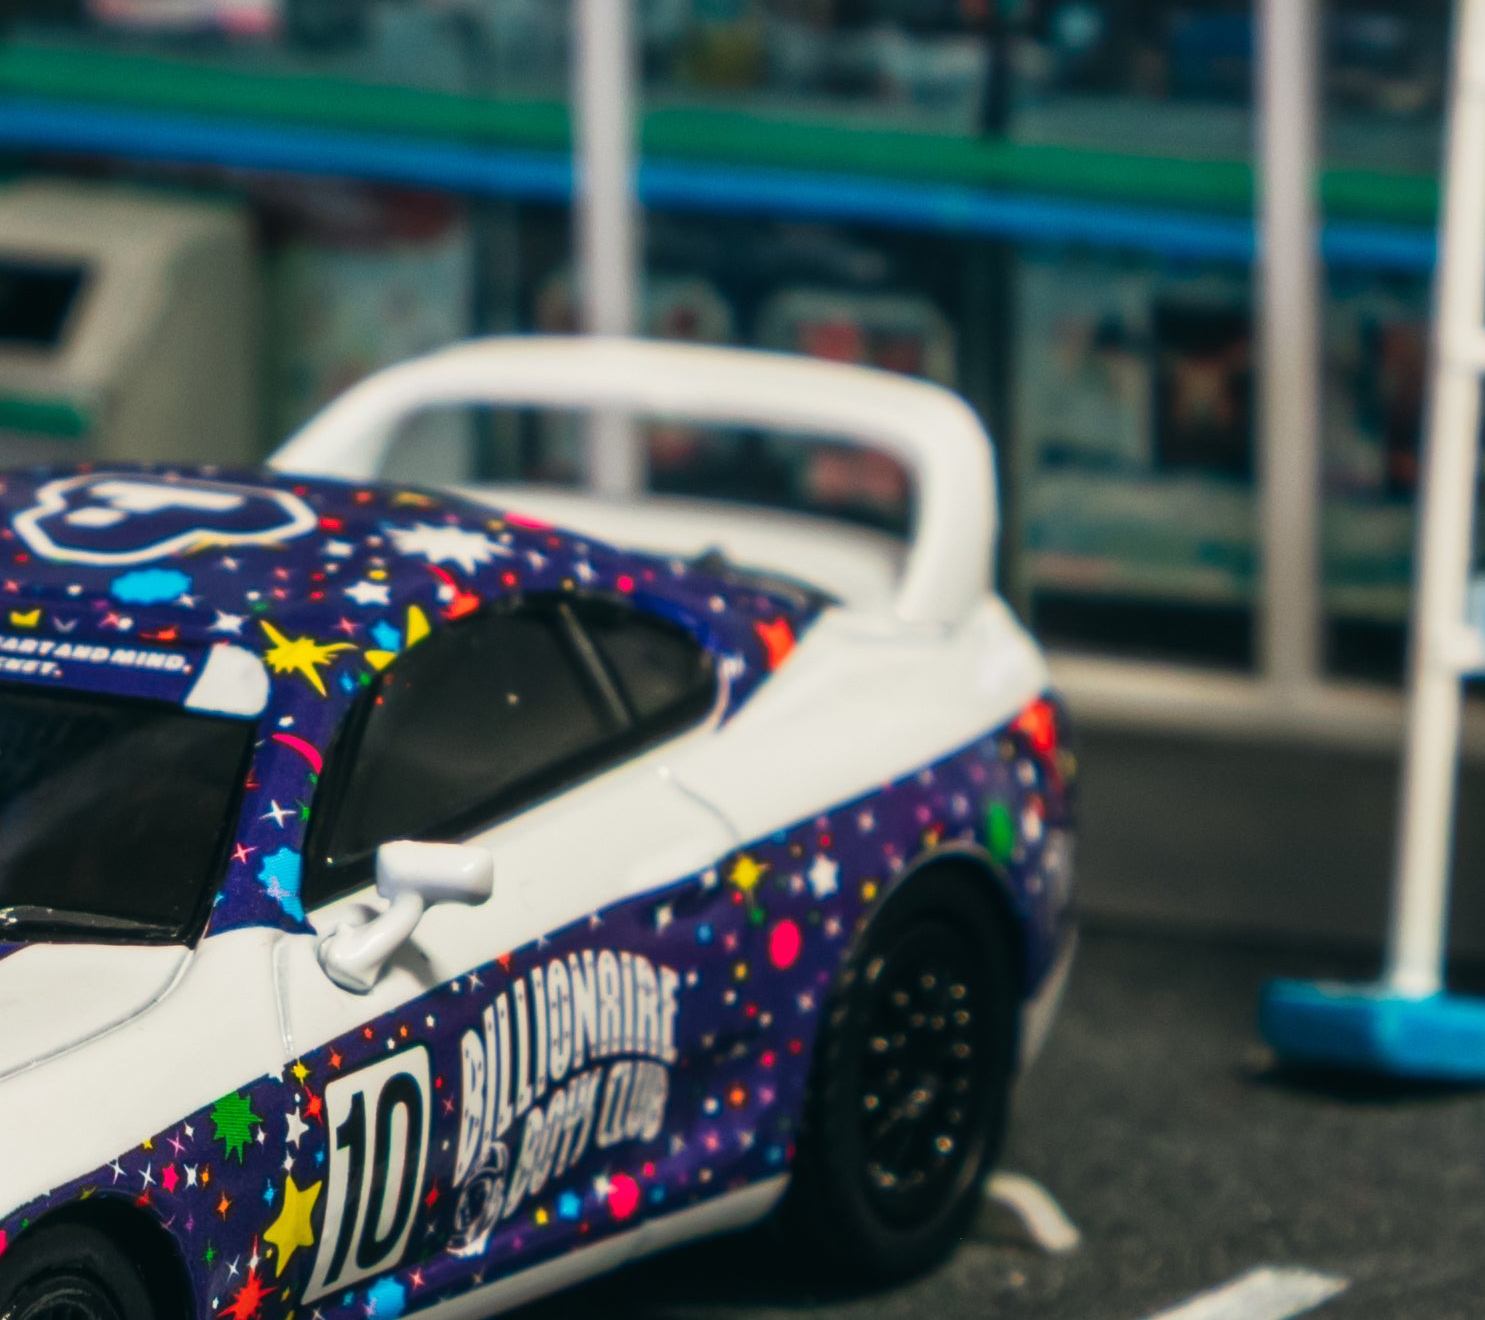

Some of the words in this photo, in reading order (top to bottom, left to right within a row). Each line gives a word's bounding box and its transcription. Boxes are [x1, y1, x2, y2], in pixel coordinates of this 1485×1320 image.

[52, 641, 110, 664] AND
[109, 648, 193, 675] MIND.
[453, 947, 680, 1189] BILLIONAIRE
[322, 1071, 424, 1289] 10
